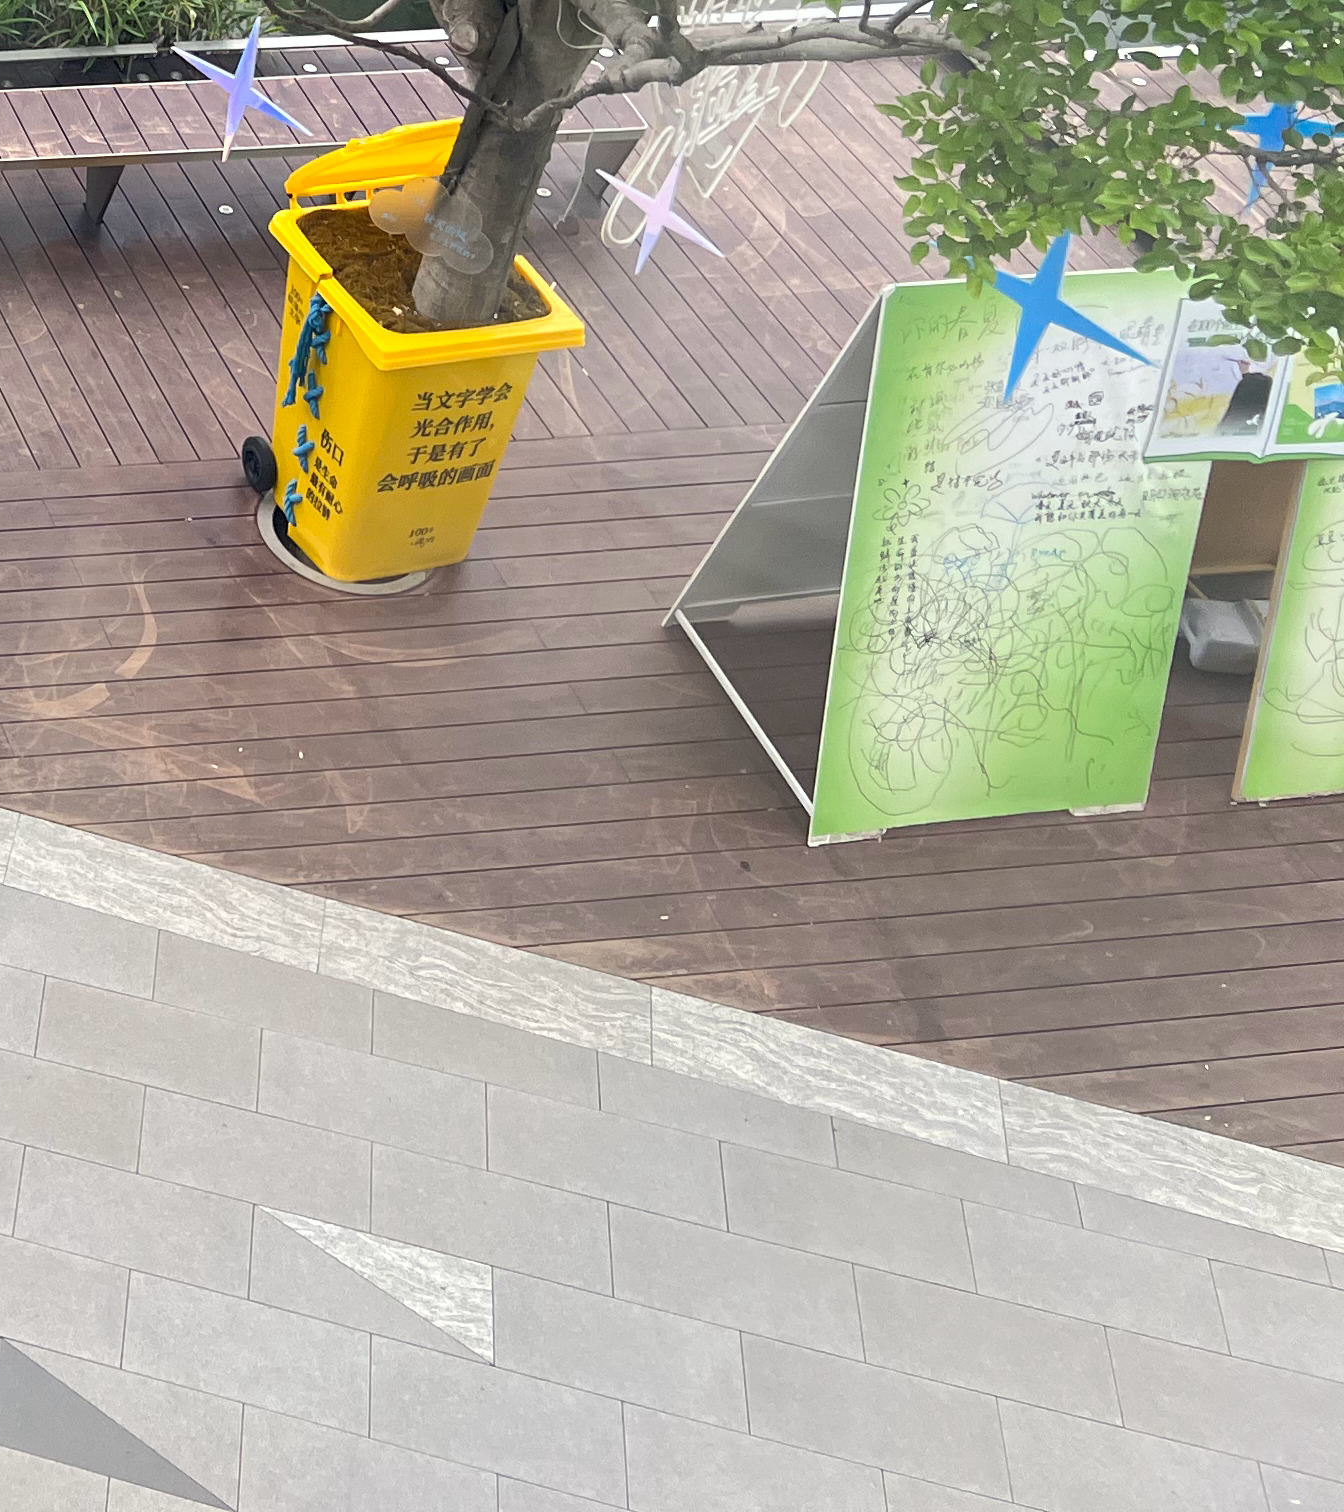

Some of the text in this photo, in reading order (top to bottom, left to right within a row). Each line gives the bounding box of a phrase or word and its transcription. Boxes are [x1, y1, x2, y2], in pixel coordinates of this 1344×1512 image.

[412, 382, 512, 411] 当文字学会
[320, 428, 344, 466] 伤口
[407, 437, 487, 464] 于是有了
[377, 459, 496, 493] 会呼吸的画面
